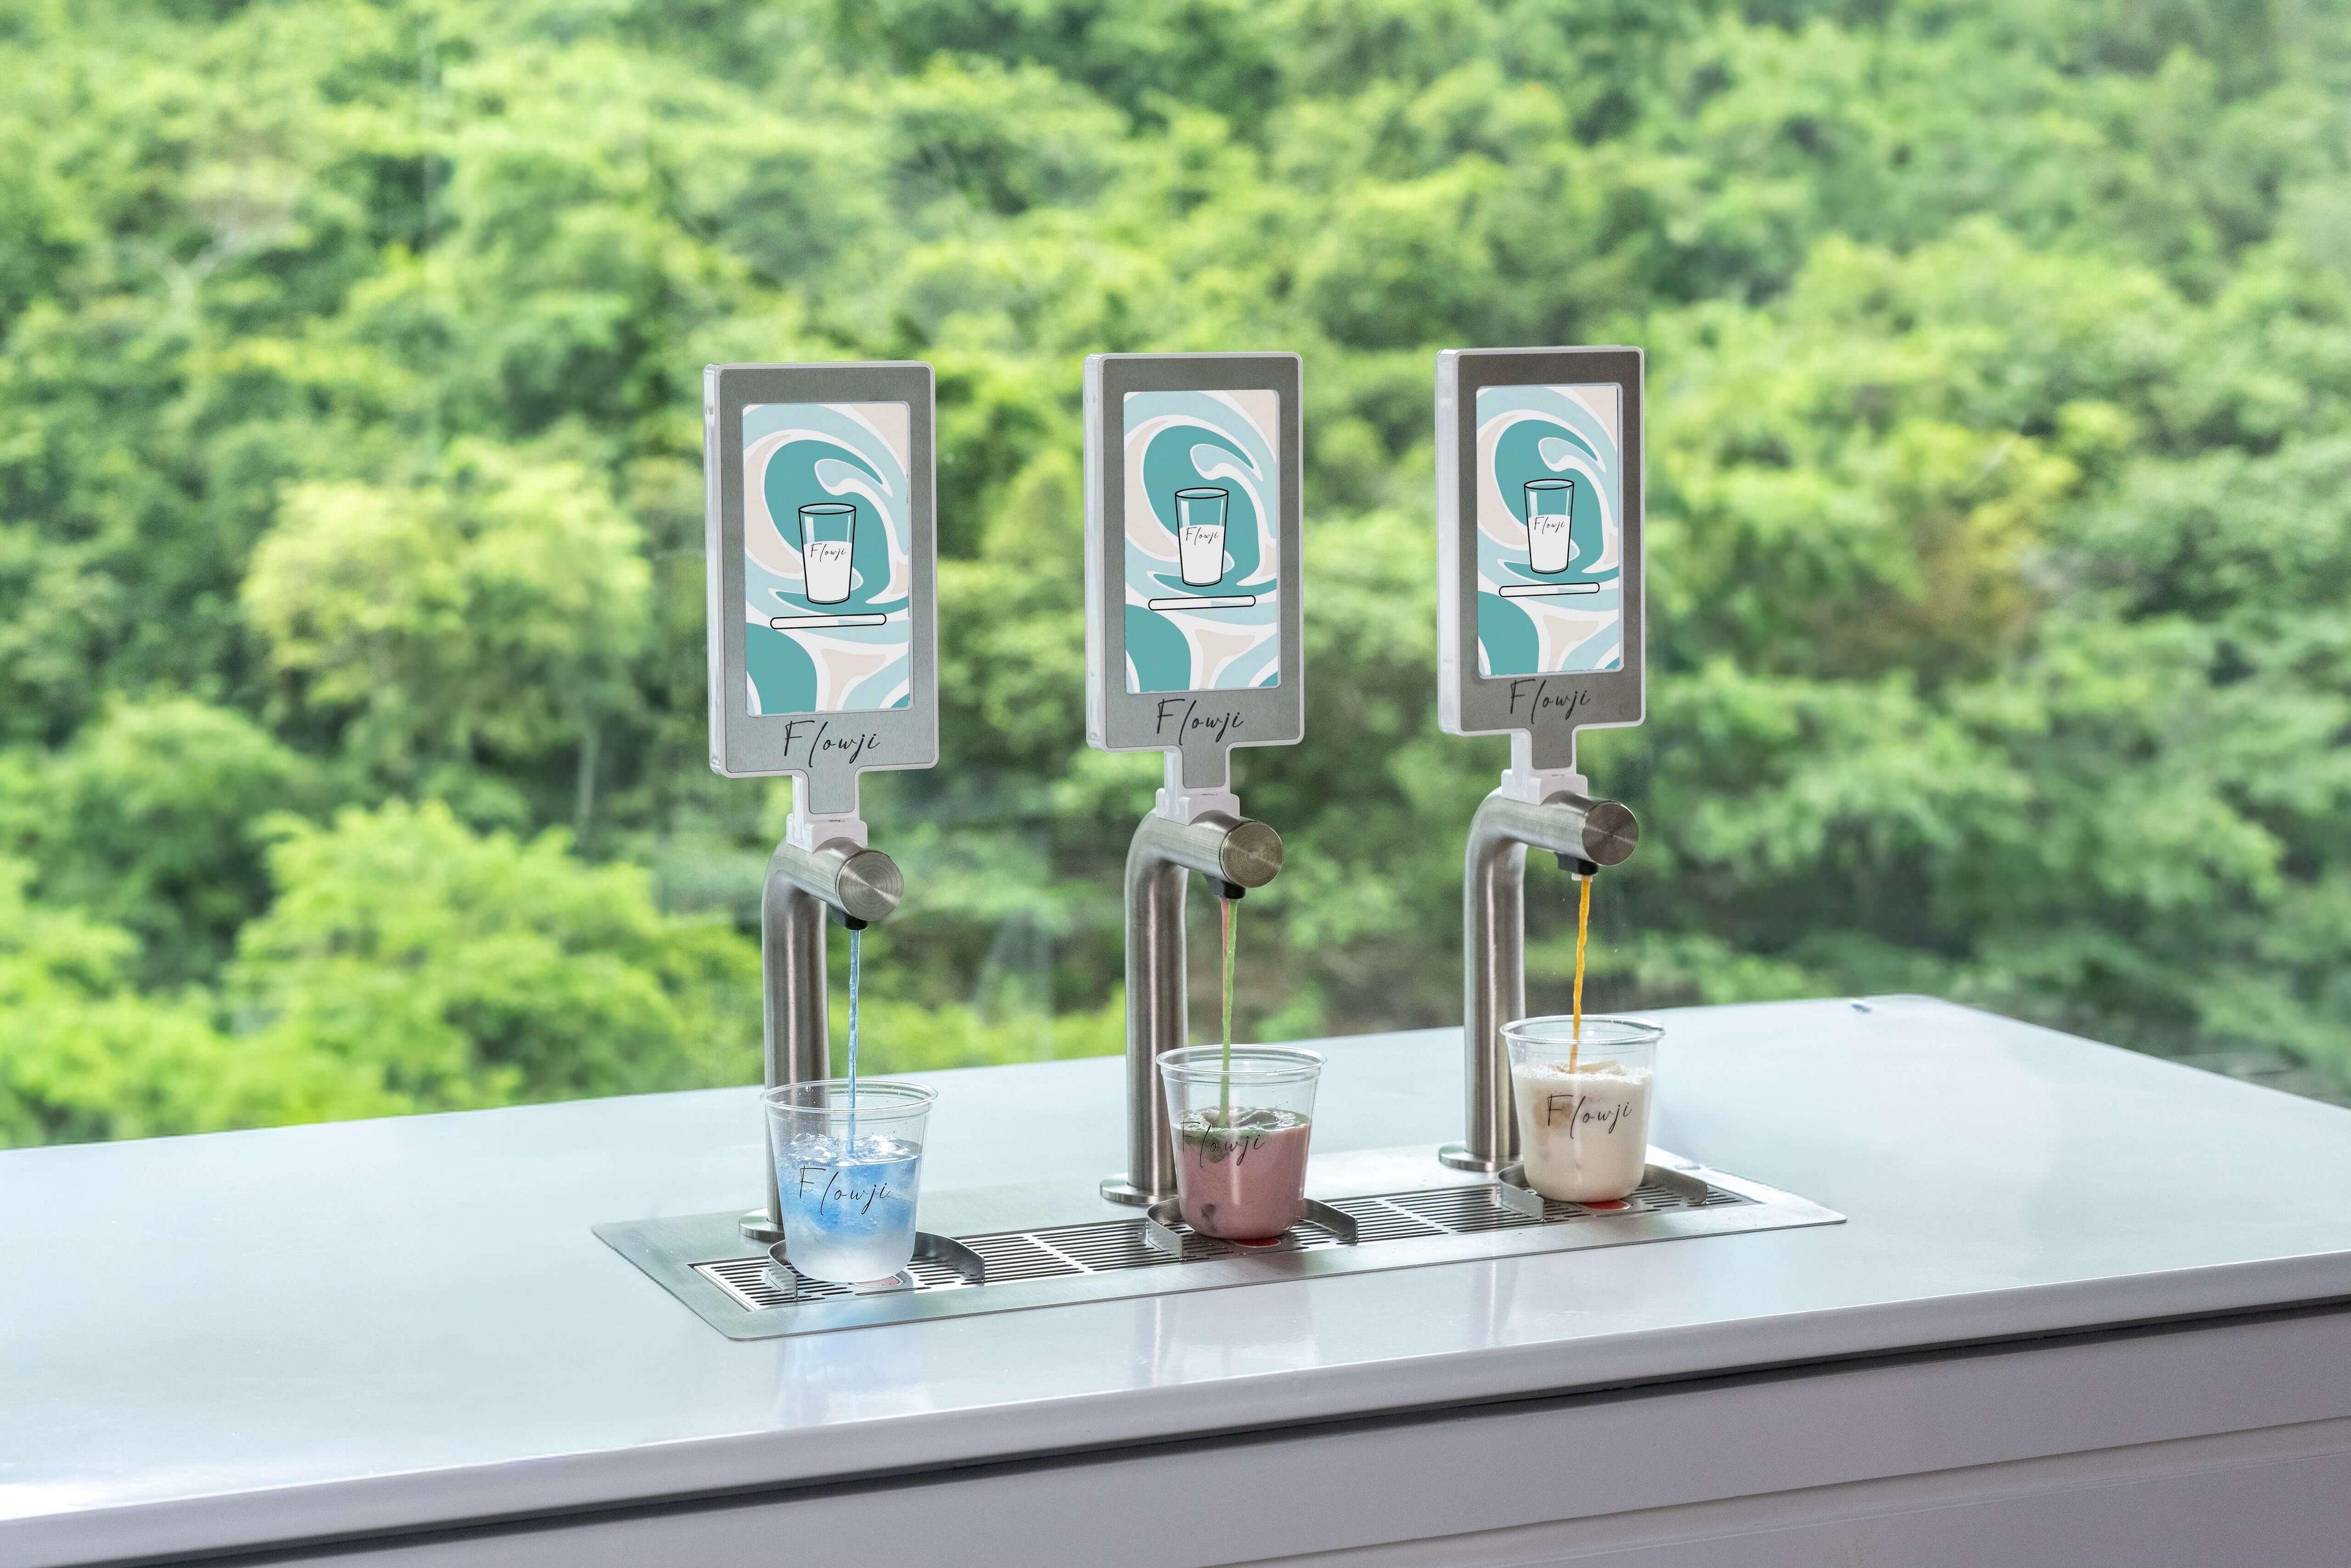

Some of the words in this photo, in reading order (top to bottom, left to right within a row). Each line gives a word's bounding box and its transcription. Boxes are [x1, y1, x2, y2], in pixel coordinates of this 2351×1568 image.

[1186, 527, 1219, 546] Flowji
[1534, 516, 1565, 534] Flowji
[810, 542, 846, 562] Flowji
[1157, 698, 1244, 746] Flowji
[1510, 678, 1591, 724] Flowji
[784, 720, 880, 768] Flowji
[1547, 1093, 1632, 1139] Flowji
[1180, 1119, 1265, 1168] Flowji
[799, 1165, 891, 1215] Flowji
